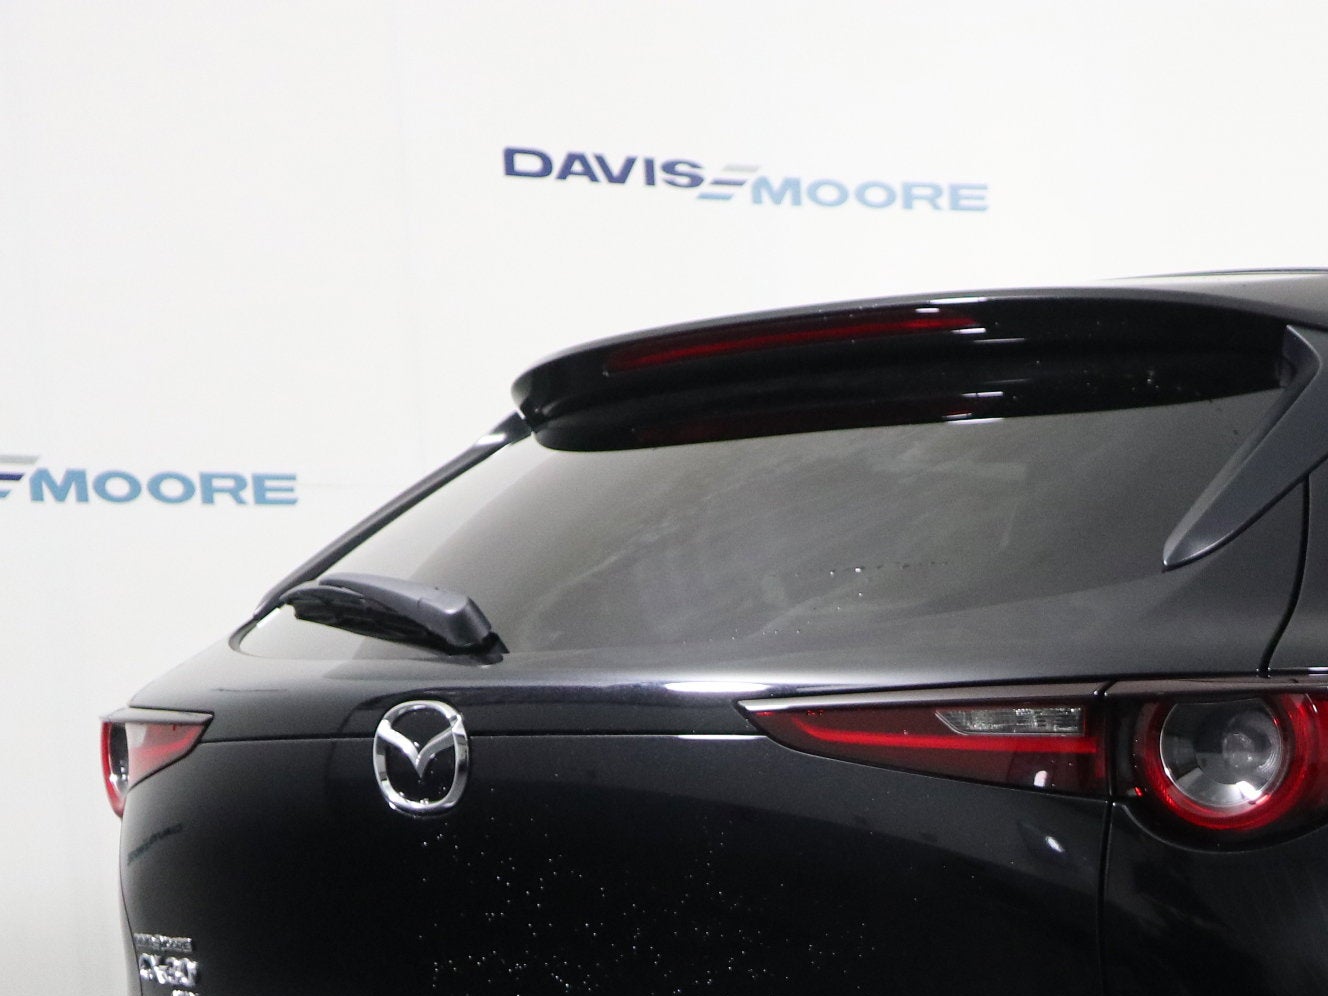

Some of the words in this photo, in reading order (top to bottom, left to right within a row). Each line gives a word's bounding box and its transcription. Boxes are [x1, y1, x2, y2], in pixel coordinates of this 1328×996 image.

[503, 146, 705, 189] DAVIS
[751, 176, 989, 213] MOORE
[29, 468, 299, 506] MOORE
